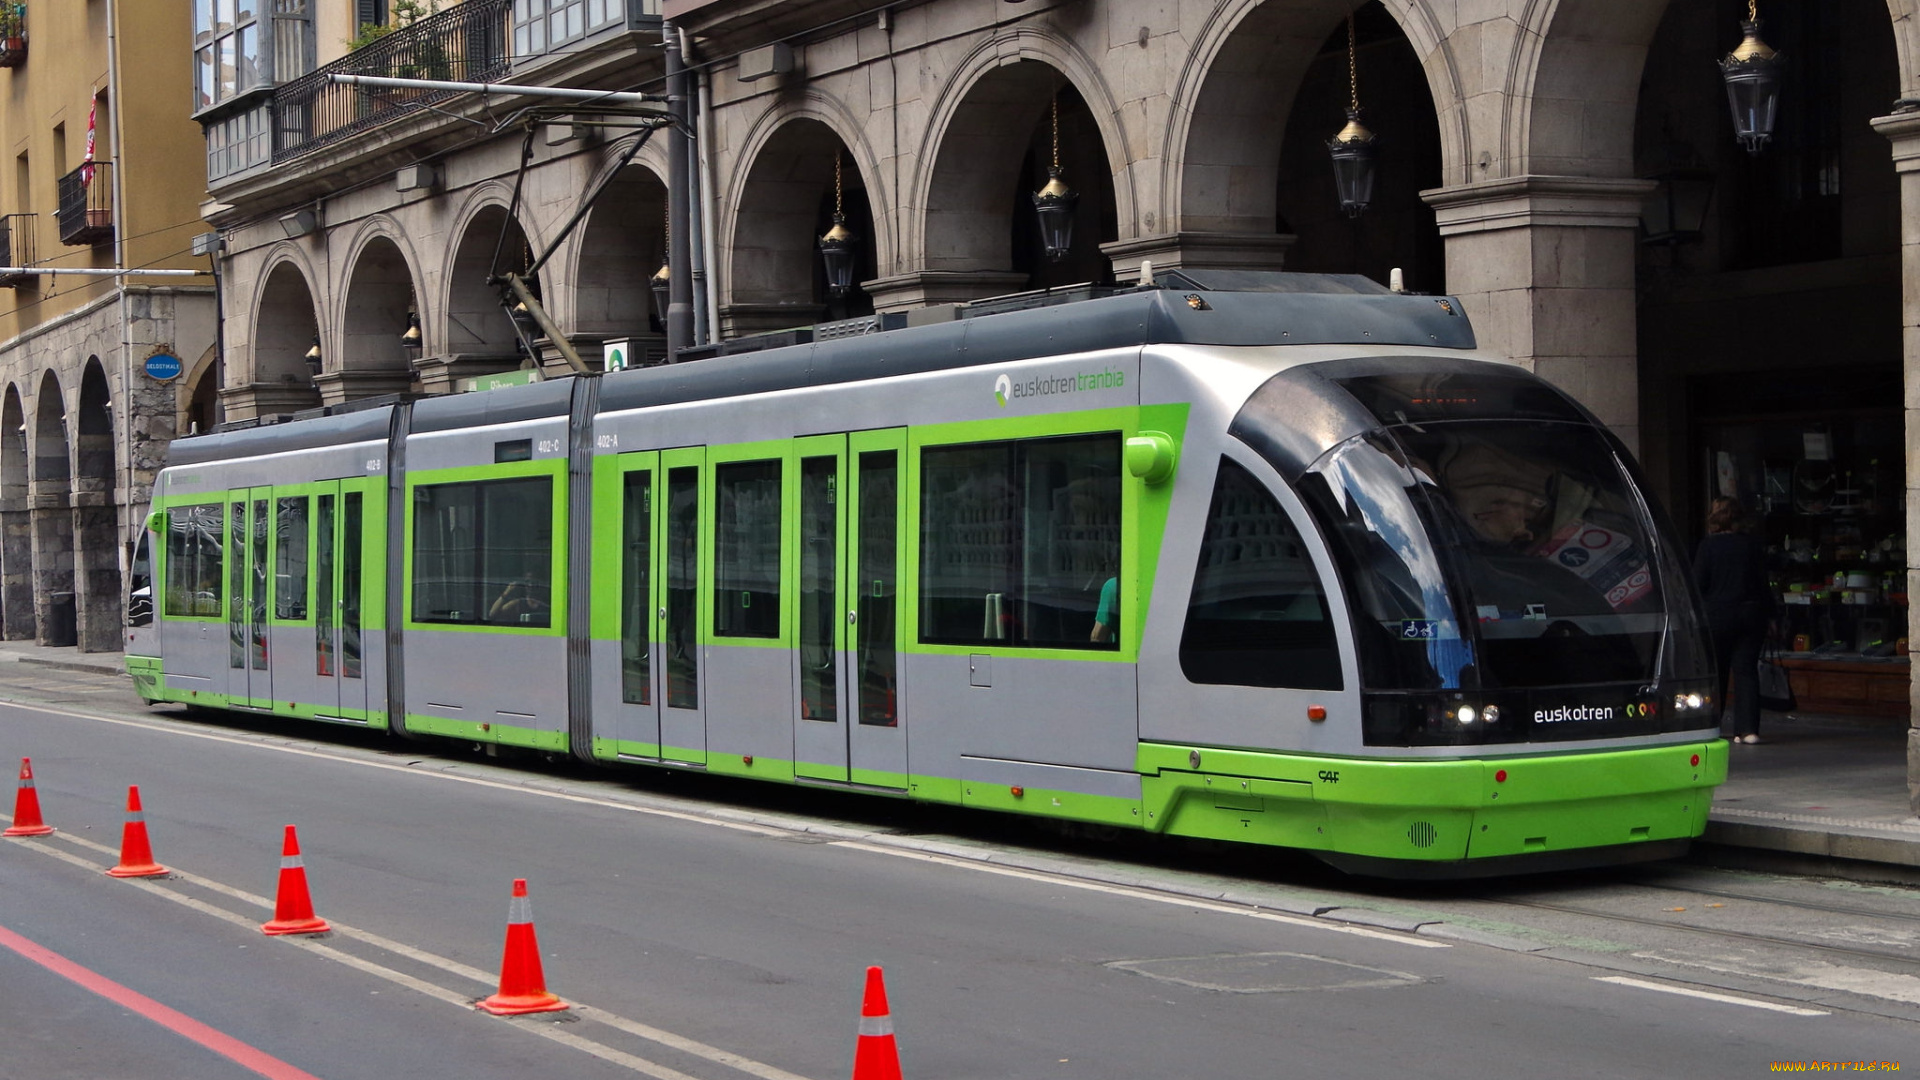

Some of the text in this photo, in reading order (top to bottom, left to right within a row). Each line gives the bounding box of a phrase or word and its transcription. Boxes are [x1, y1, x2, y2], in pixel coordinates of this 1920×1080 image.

[1013, 374, 1076, 398] euskotren
[538, 439, 560, 453] 402-C
[597, 434, 618, 448] 402-A
[1534, 704, 1613, 723] euskotren
[1318, 770, 1339, 783] CAF
